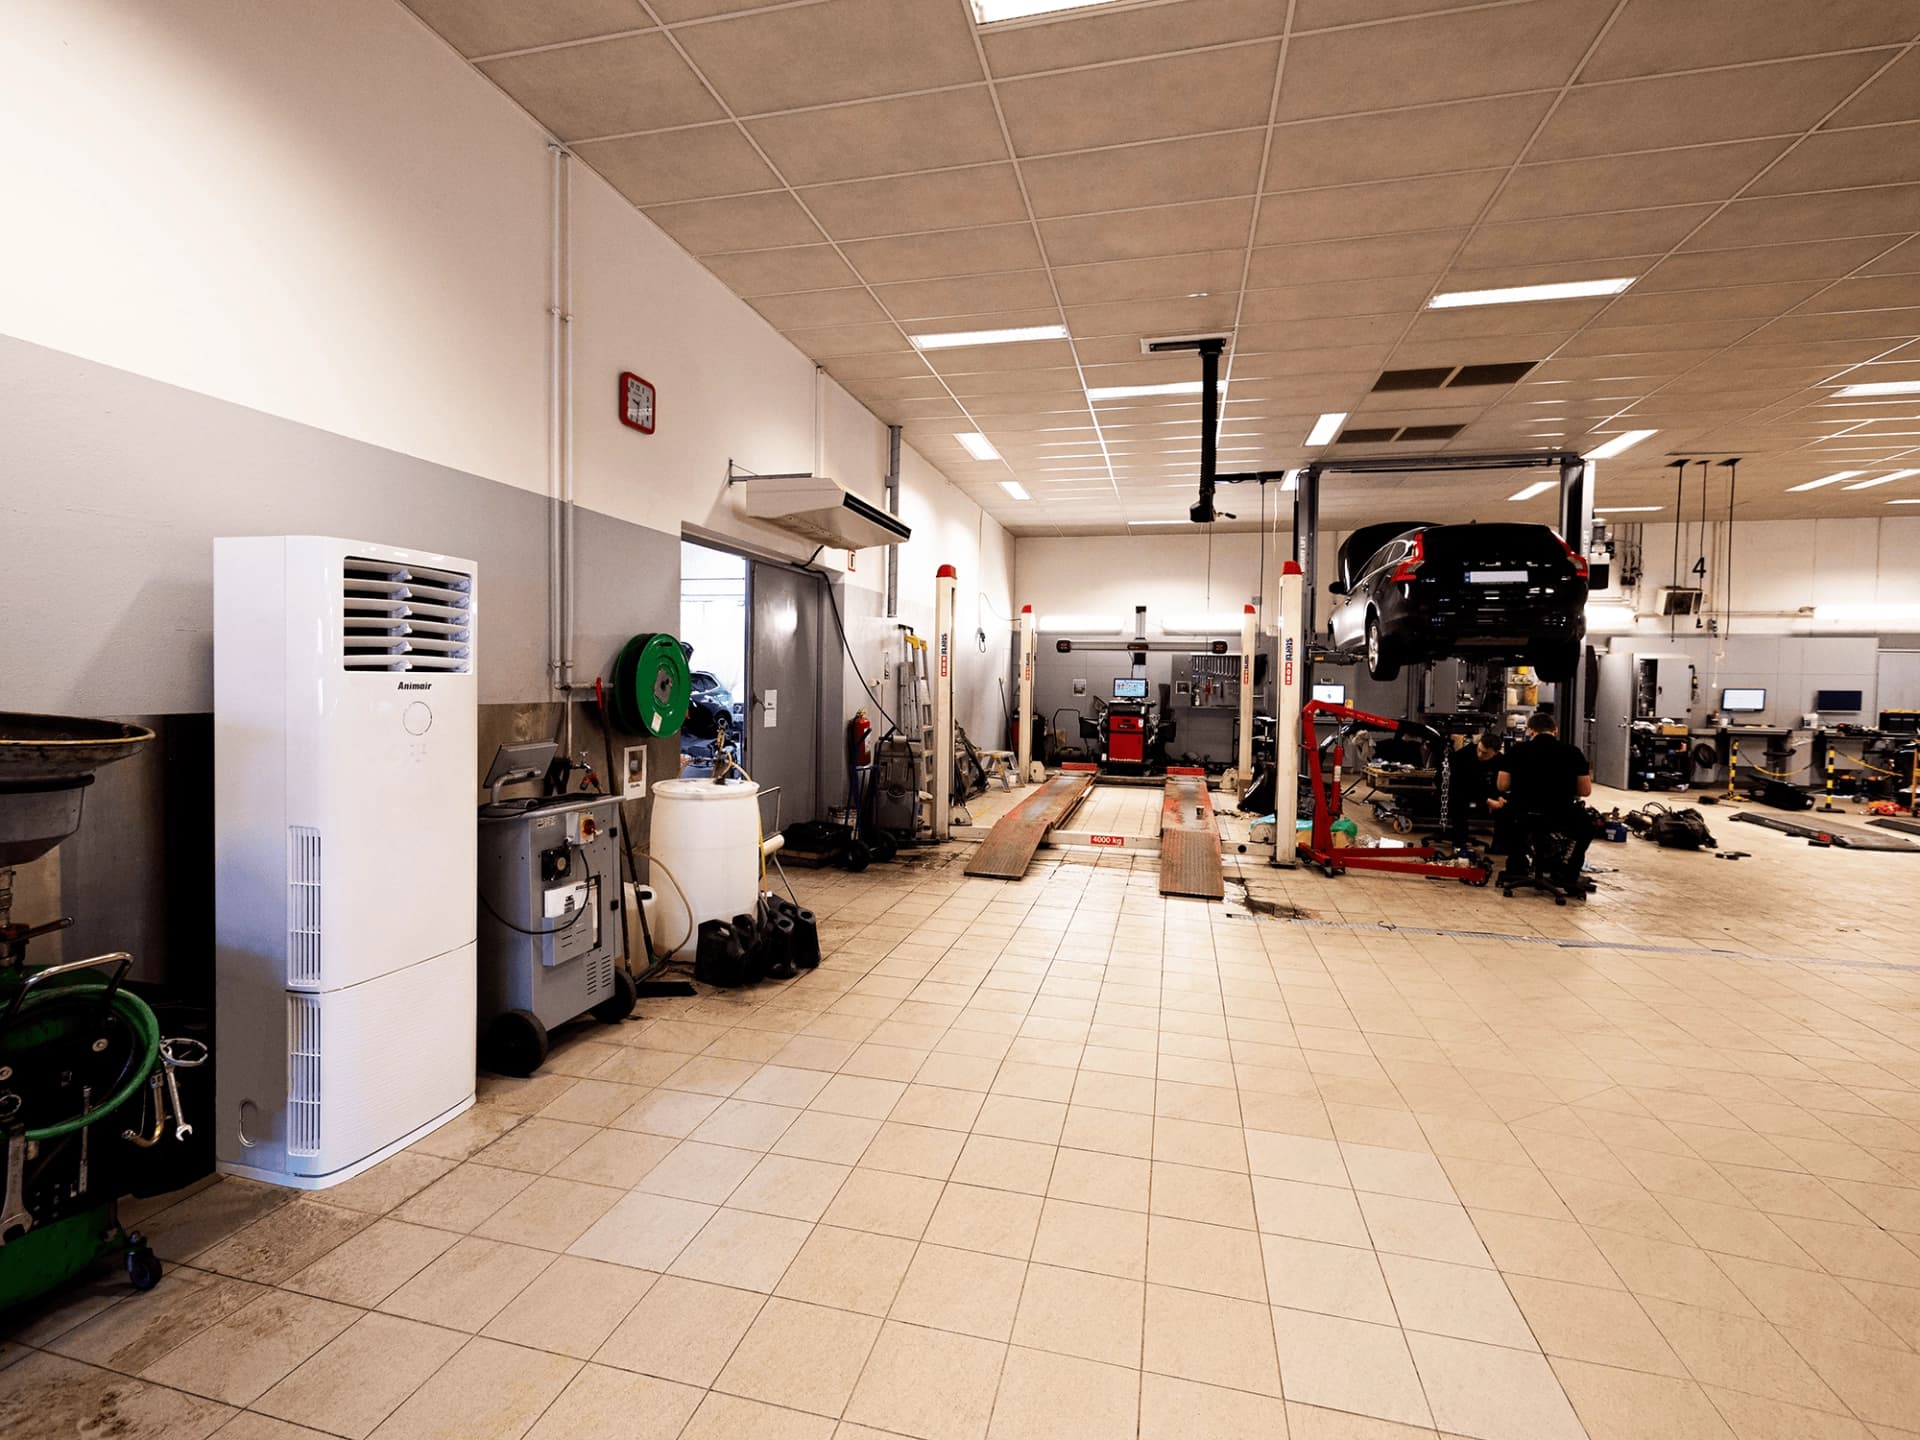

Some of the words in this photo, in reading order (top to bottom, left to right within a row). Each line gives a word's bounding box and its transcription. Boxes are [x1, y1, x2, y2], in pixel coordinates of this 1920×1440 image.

[1692, 557, 1706, 578] 4
[397, 681, 432, 690] Animair
[1092, 836, 1111, 844] 4000
